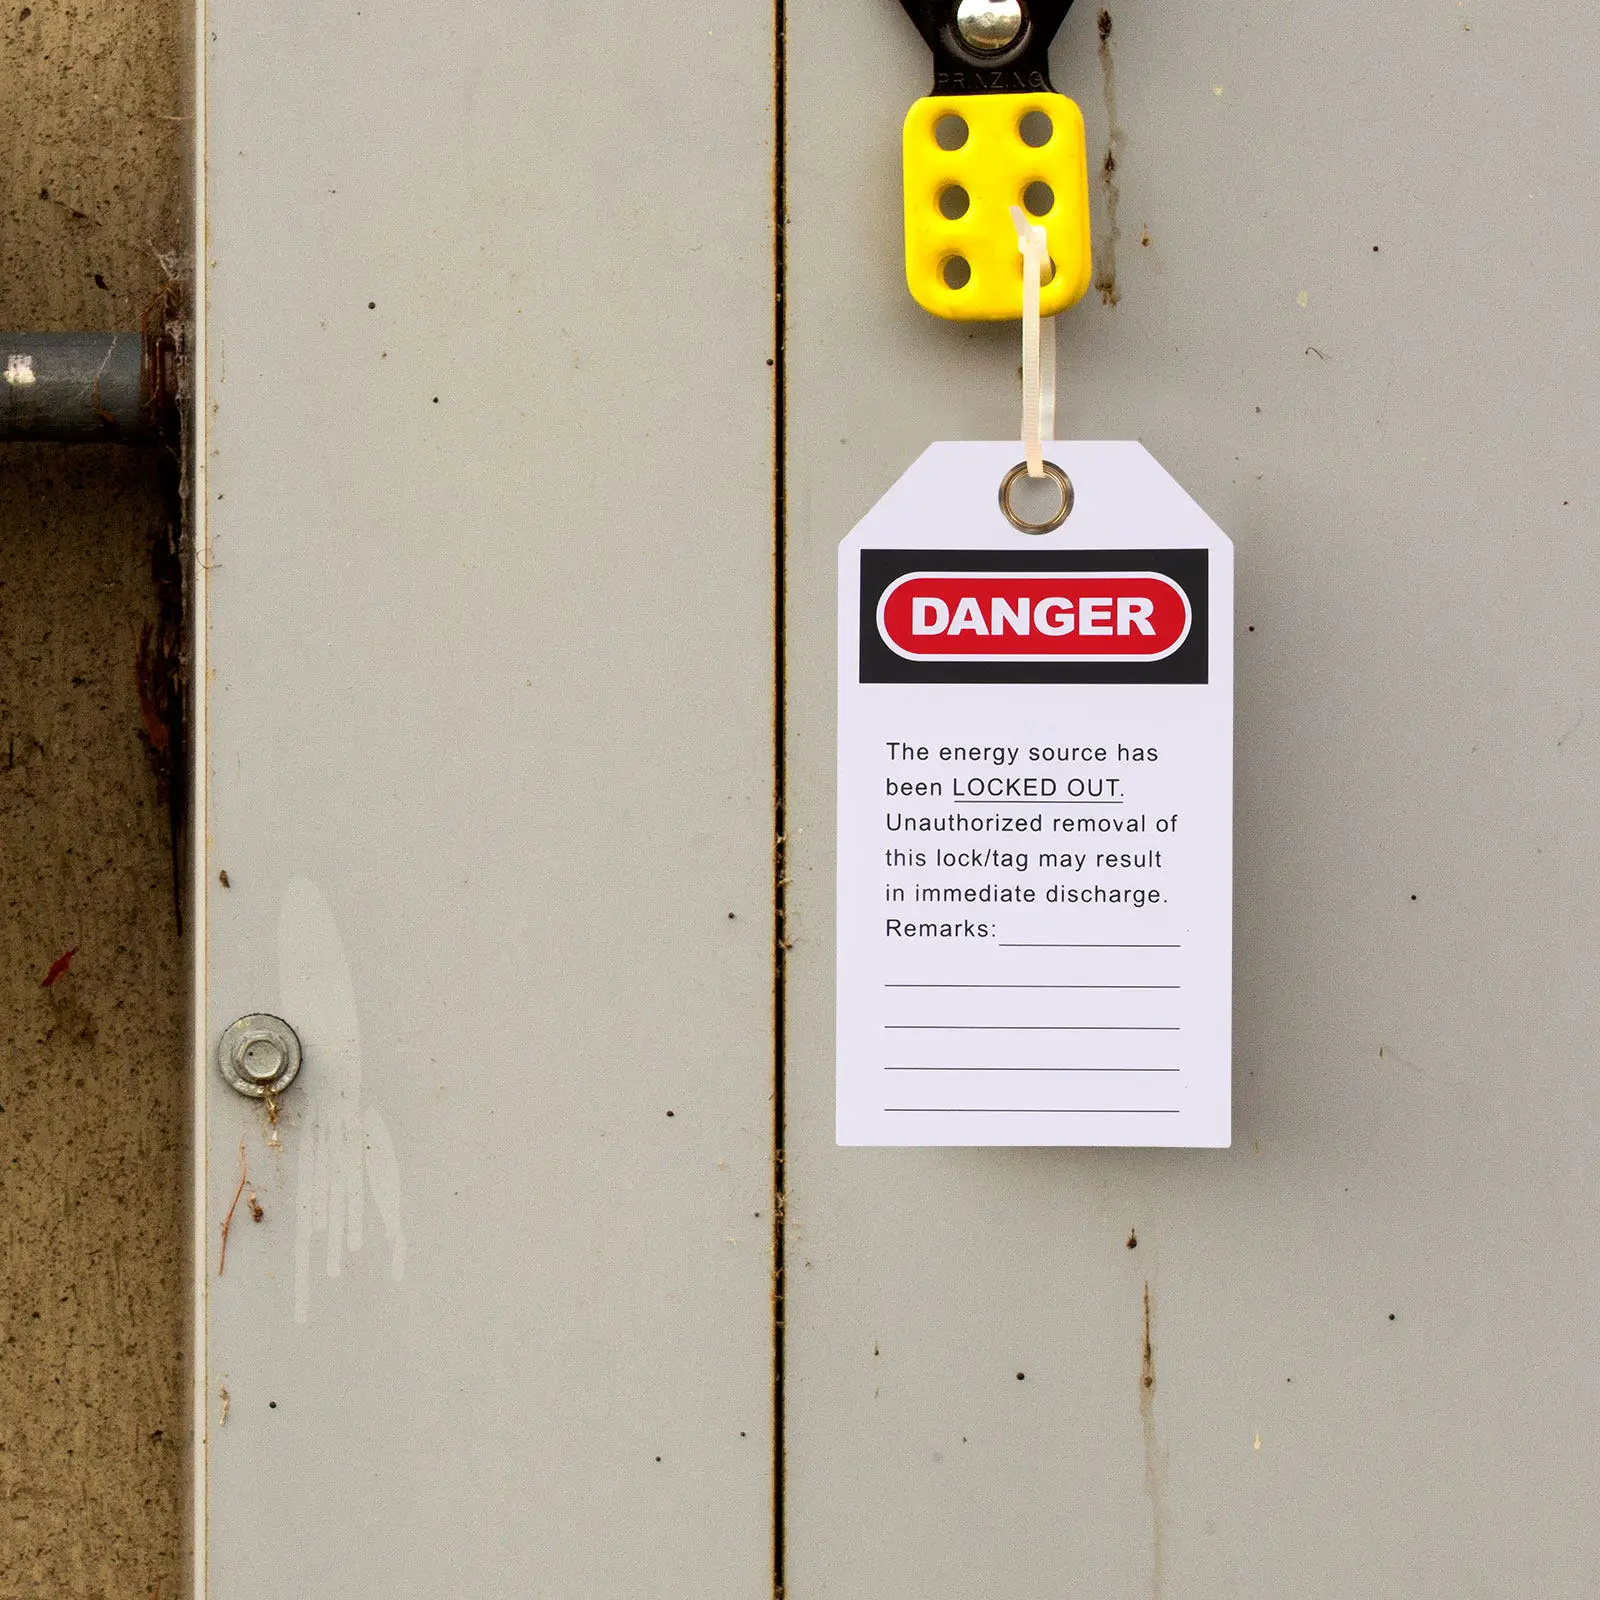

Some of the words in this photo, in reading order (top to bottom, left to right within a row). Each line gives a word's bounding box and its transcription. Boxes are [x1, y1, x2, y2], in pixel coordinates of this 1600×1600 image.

[912, 596, 1156, 637] DANGER
[886, 743, 928, 761] The
[940, 747, 1019, 766] energy
[1029, 747, 1106, 762] source
[1119, 744, 1159, 762] has
[886, 778, 942, 796] been
[953, 778, 1057, 797] LOCKED
[1067, 778, 1124, 797] OUT.
[886, 813, 1042, 832] Unauthorized
[1053, 814, 1145, 832] removal
[1156, 814, 1178, 832] of
[885, 849, 926, 867] this
[937, 849, 1028, 871] lock/tag
[1039, 853, 1087, 871] may
[1096, 850, 1162, 868] result
[886, 884, 904, 902] in
[915, 884, 1036, 902] immediate
[1045, 885, 1168, 907] discharge.
[886, 919, 996, 937] Remarks:
